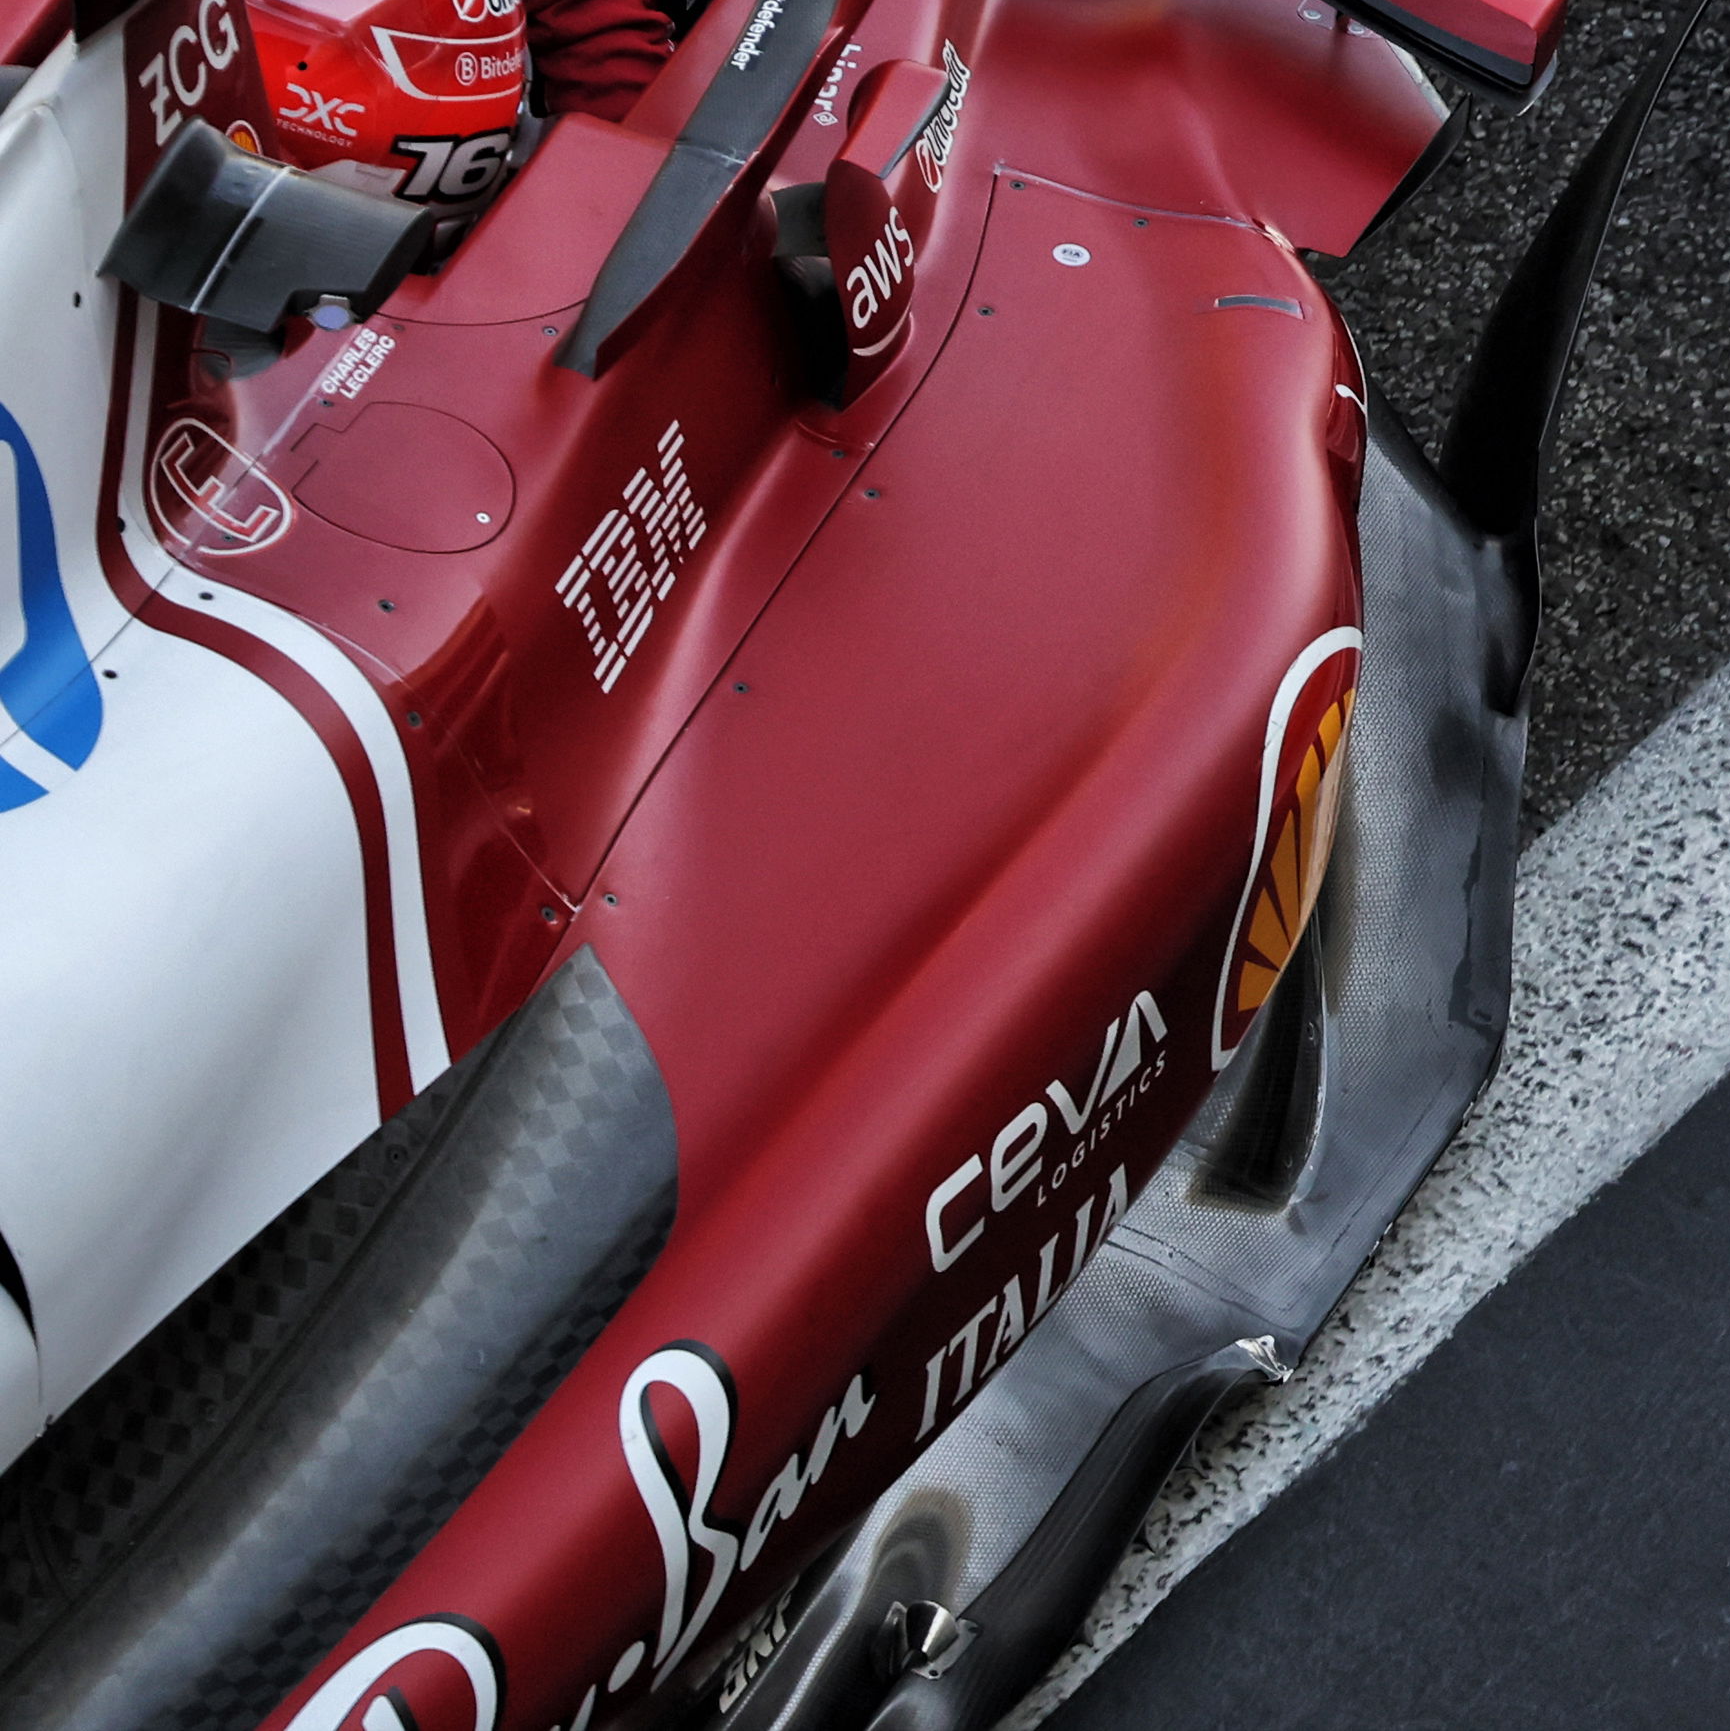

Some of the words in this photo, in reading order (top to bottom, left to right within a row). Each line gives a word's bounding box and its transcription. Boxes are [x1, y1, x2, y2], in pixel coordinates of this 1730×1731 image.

[275, 118, 354, 148] TECHNOLOGY
[278, 82, 367, 137] DXC
[395, 132, 510, 198] 16
[845, 205, 915, 329] aws
[321, 327, 379, 394] CHARLES
[339, 334, 397, 399] LECLERC
[554, 419, 706, 695] IBM
[1036, 1049, 1167, 1209] LOGISTICS
[913, 1162, 1128, 1443] ITALIA
